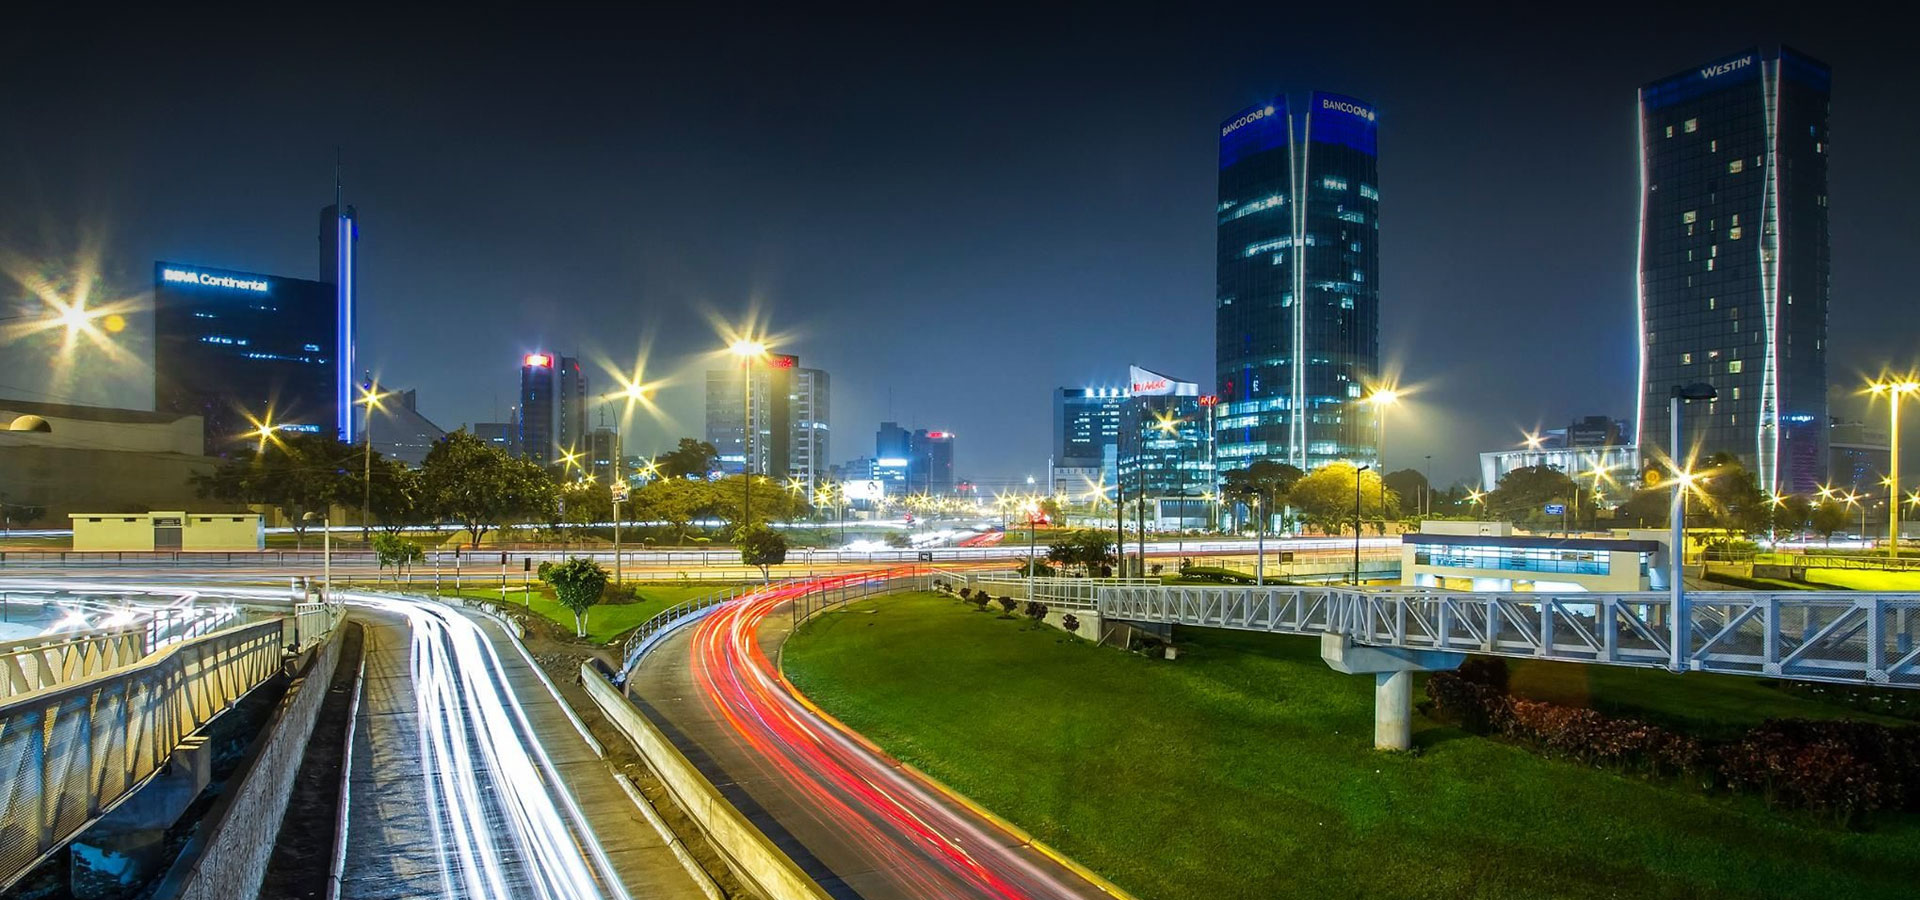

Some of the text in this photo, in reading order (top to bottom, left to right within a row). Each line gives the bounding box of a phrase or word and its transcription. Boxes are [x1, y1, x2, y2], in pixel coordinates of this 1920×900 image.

[1701, 56, 1751, 79] WESTIN
[164, 269, 268, 292] BBVA Continental
